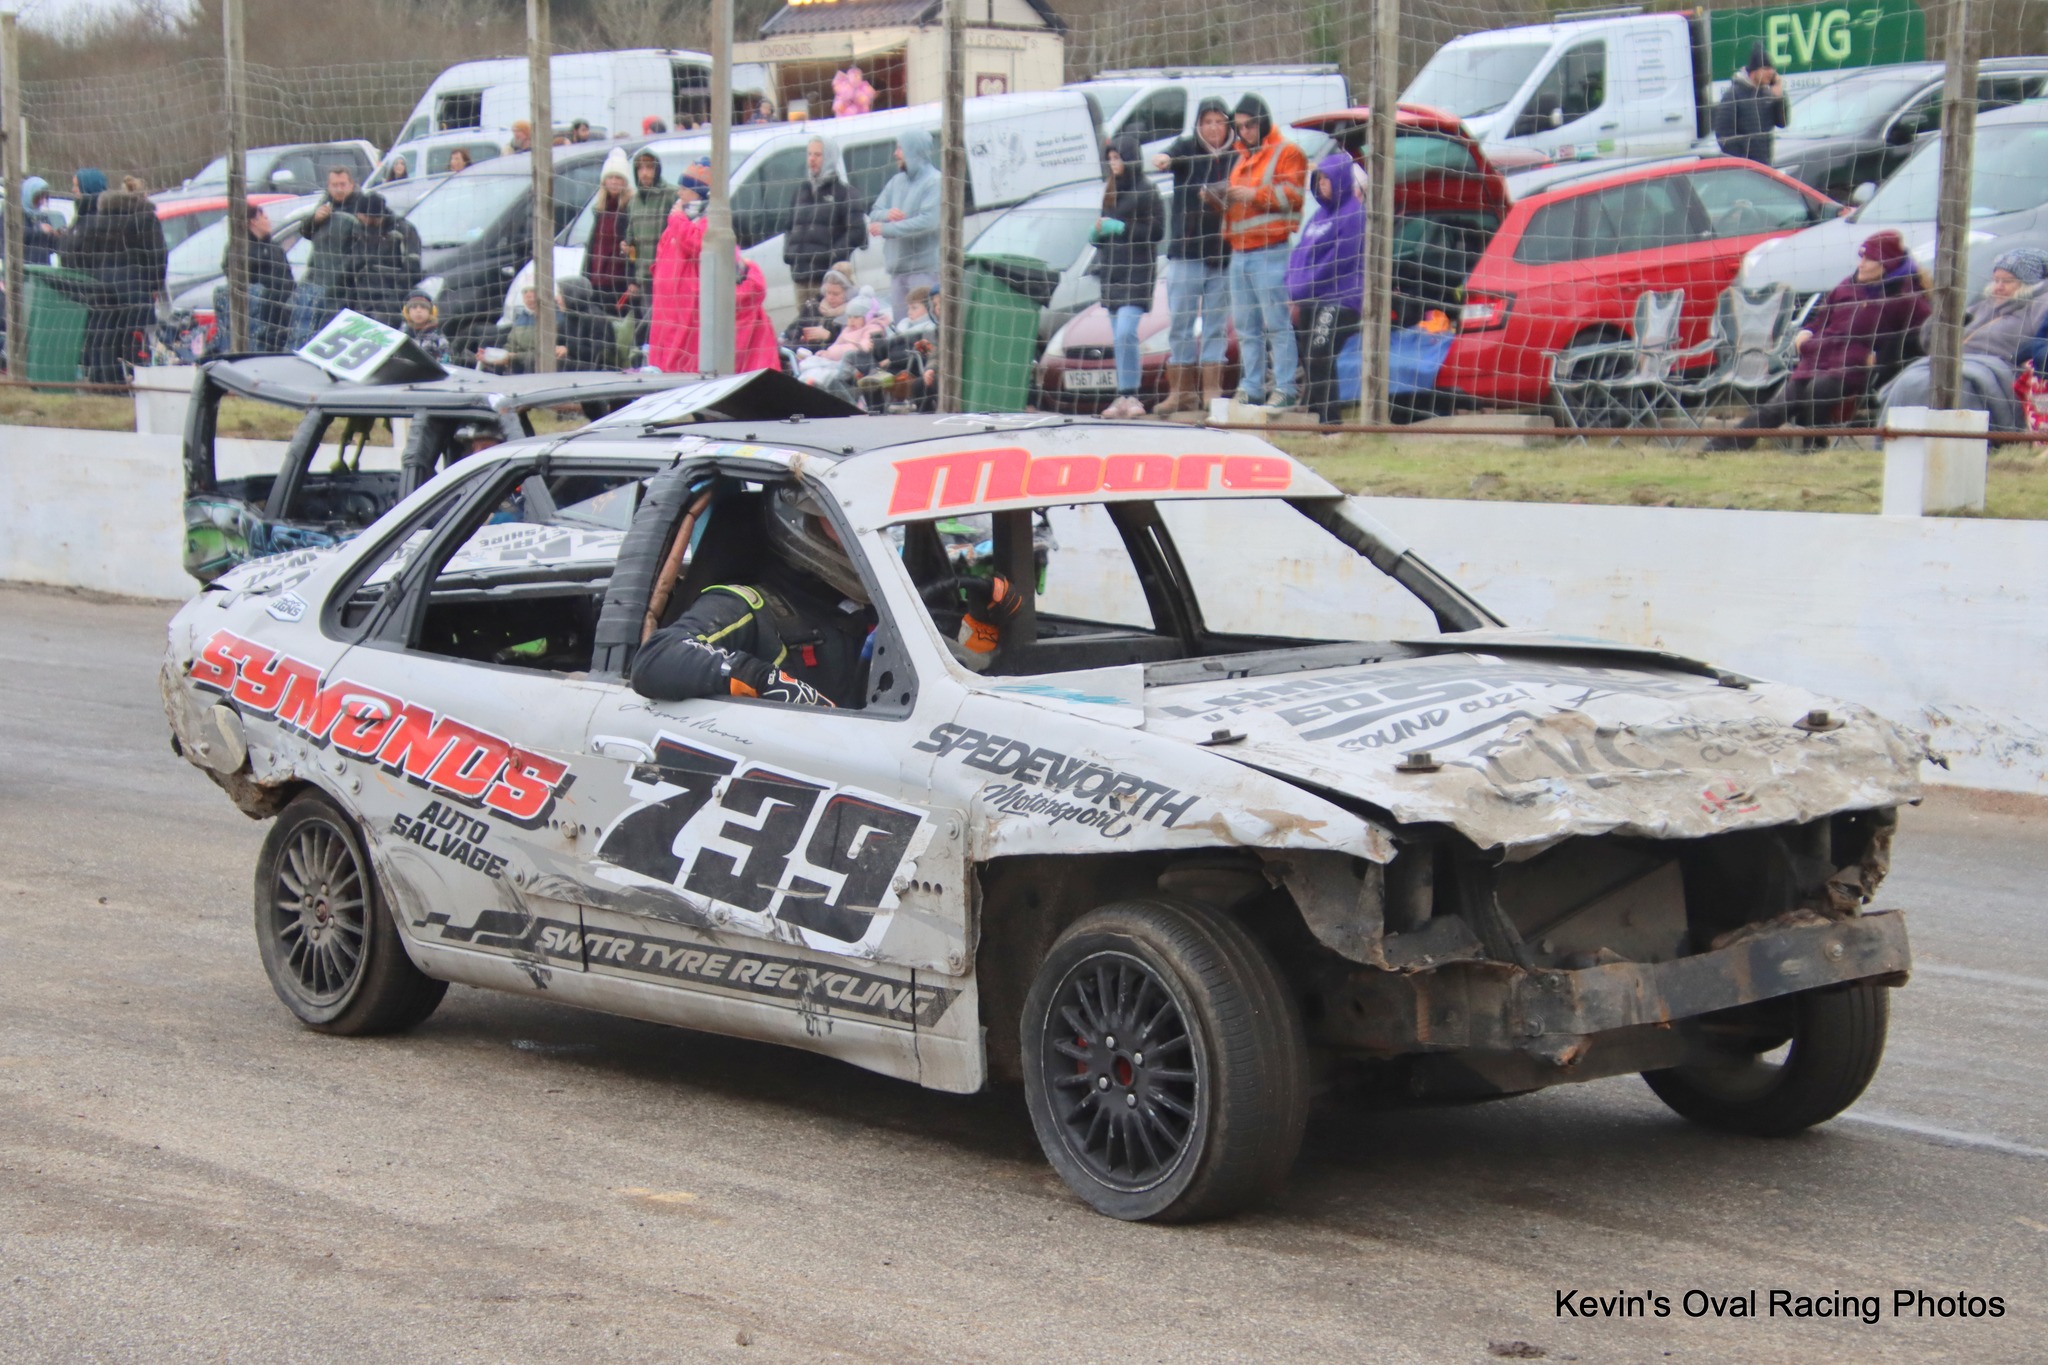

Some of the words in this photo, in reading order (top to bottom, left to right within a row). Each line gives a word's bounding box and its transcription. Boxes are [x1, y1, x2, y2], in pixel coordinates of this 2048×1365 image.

[1767, 9, 1850, 67] EVG
[308, 331, 383, 371] 59
[888, 446, 1292, 516] Moore
[188, 627, 575, 824] SYMONDS
[1337, 707, 1450, 752] SOUND
[911, 722, 1202, 828] SPEDEWORTH
[416, 800, 490, 845] AUTO
[597, 735, 923, 944] 739
[981, 782, 1133, 838] Motorsport
[389, 812, 509, 880] SALVAGE
[535, 925, 636, 962] SWTR
[639, 943, 724, 978] TYRE
[728, 958, 936, 1015] RECYCLING
